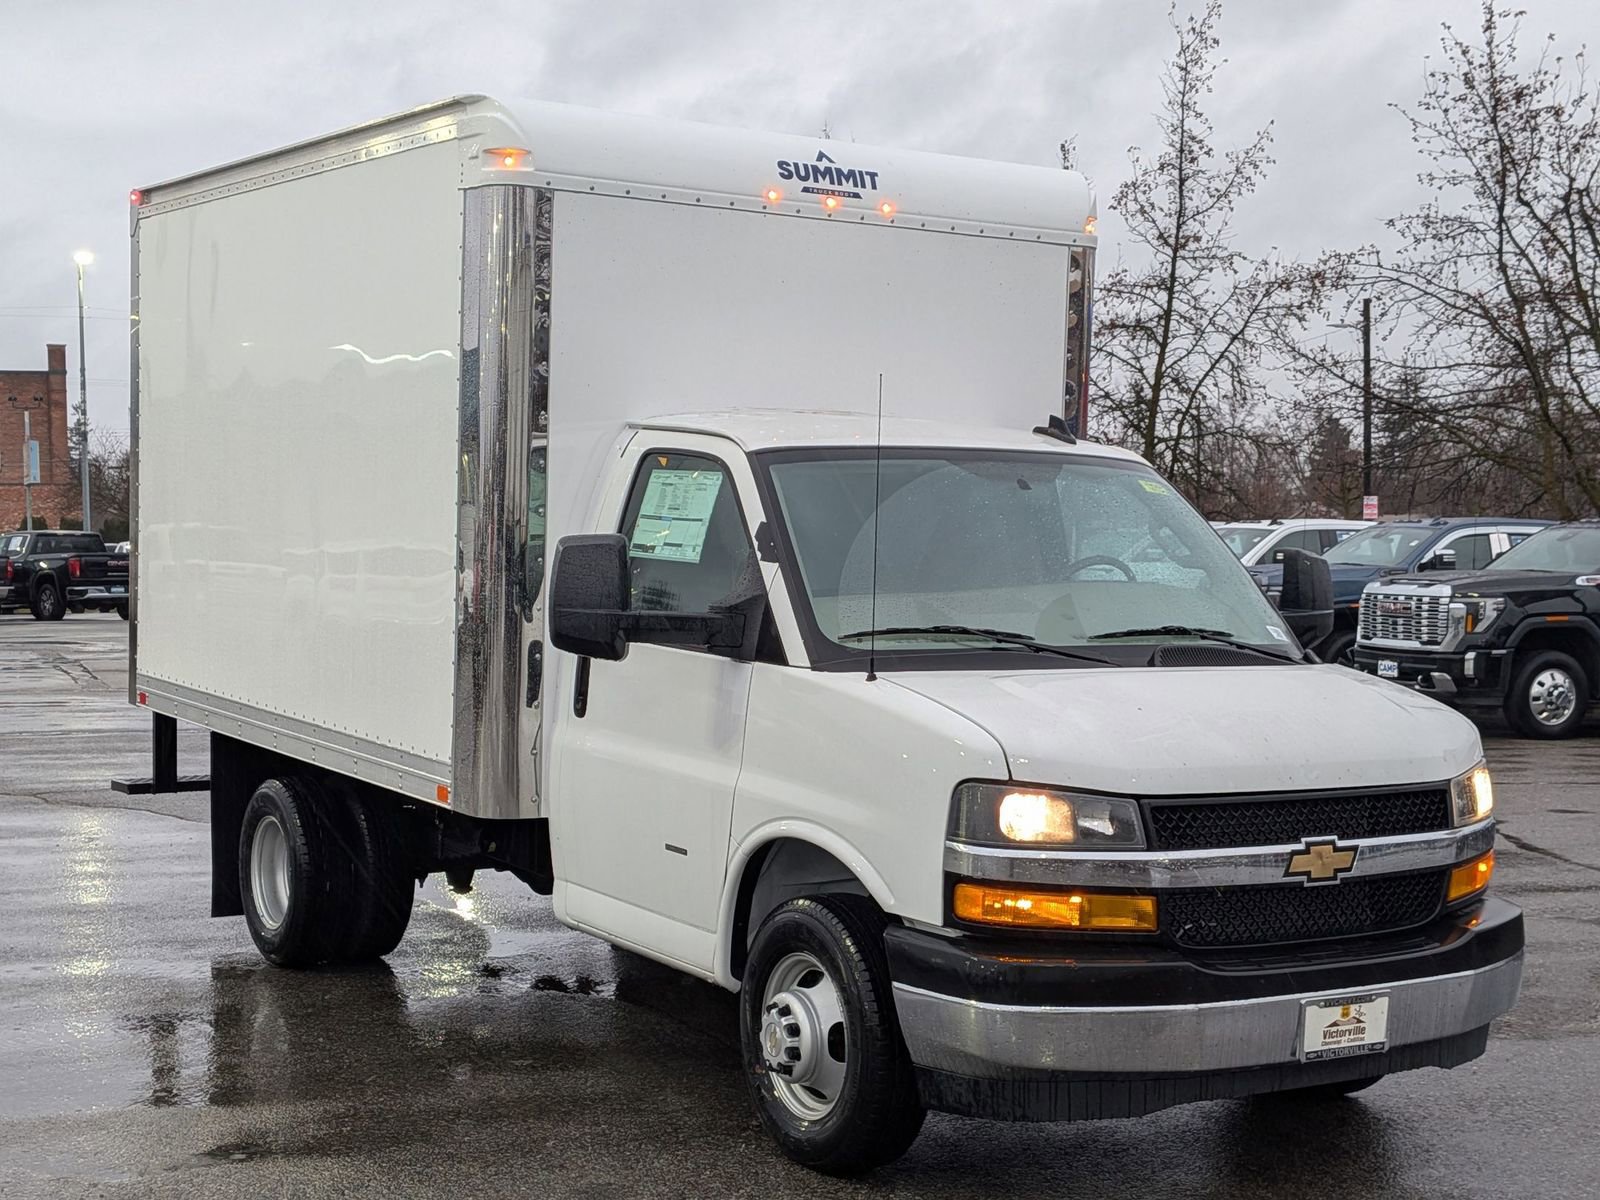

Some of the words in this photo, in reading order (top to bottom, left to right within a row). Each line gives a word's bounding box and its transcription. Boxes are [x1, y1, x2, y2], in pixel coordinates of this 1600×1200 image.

[777, 160, 879, 190] SUMMIT
[1379, 663, 1398, 673] CAMP
[1322, 1025, 1367, 1040] Victorville
[1322, 1044, 1370, 1058] VICTORVILLE
